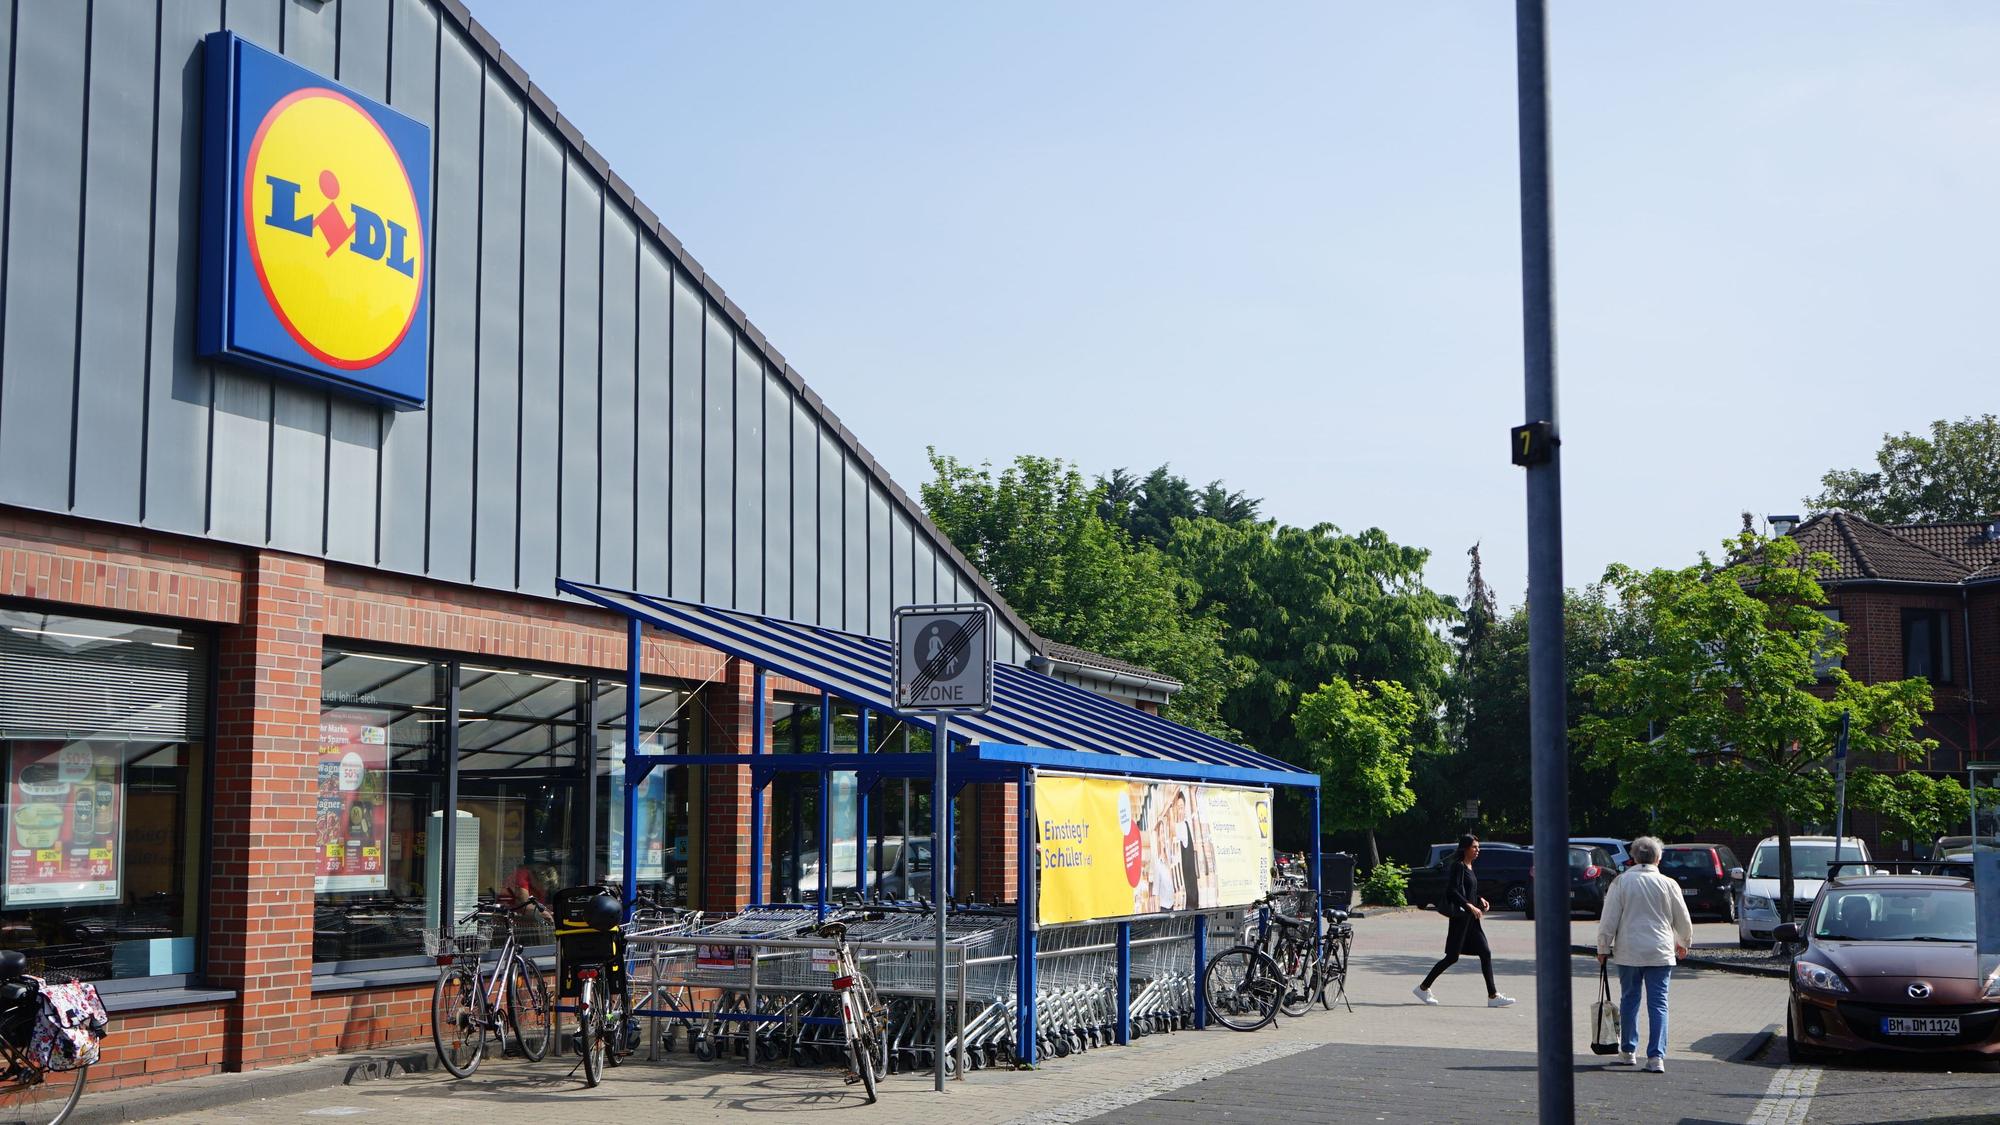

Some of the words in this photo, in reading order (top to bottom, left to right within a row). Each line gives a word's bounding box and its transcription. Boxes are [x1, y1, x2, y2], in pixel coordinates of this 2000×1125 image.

[1520, 431, 1530, 455] 7
[339, 690, 359, 703] lohnt
[361, 692, 379, 704] sich.
[921, 686, 964, 701] ZONE
[316, 800, 341, 813] agner
[1044, 819, 1082, 844] Einstieg
[1045, 847, 1083, 869] Schüler
[1889, 1019, 1904, 1031] BM
[1912, 1019, 1927, 1032] DM
[1929, 1019, 1958, 1032] 1124
